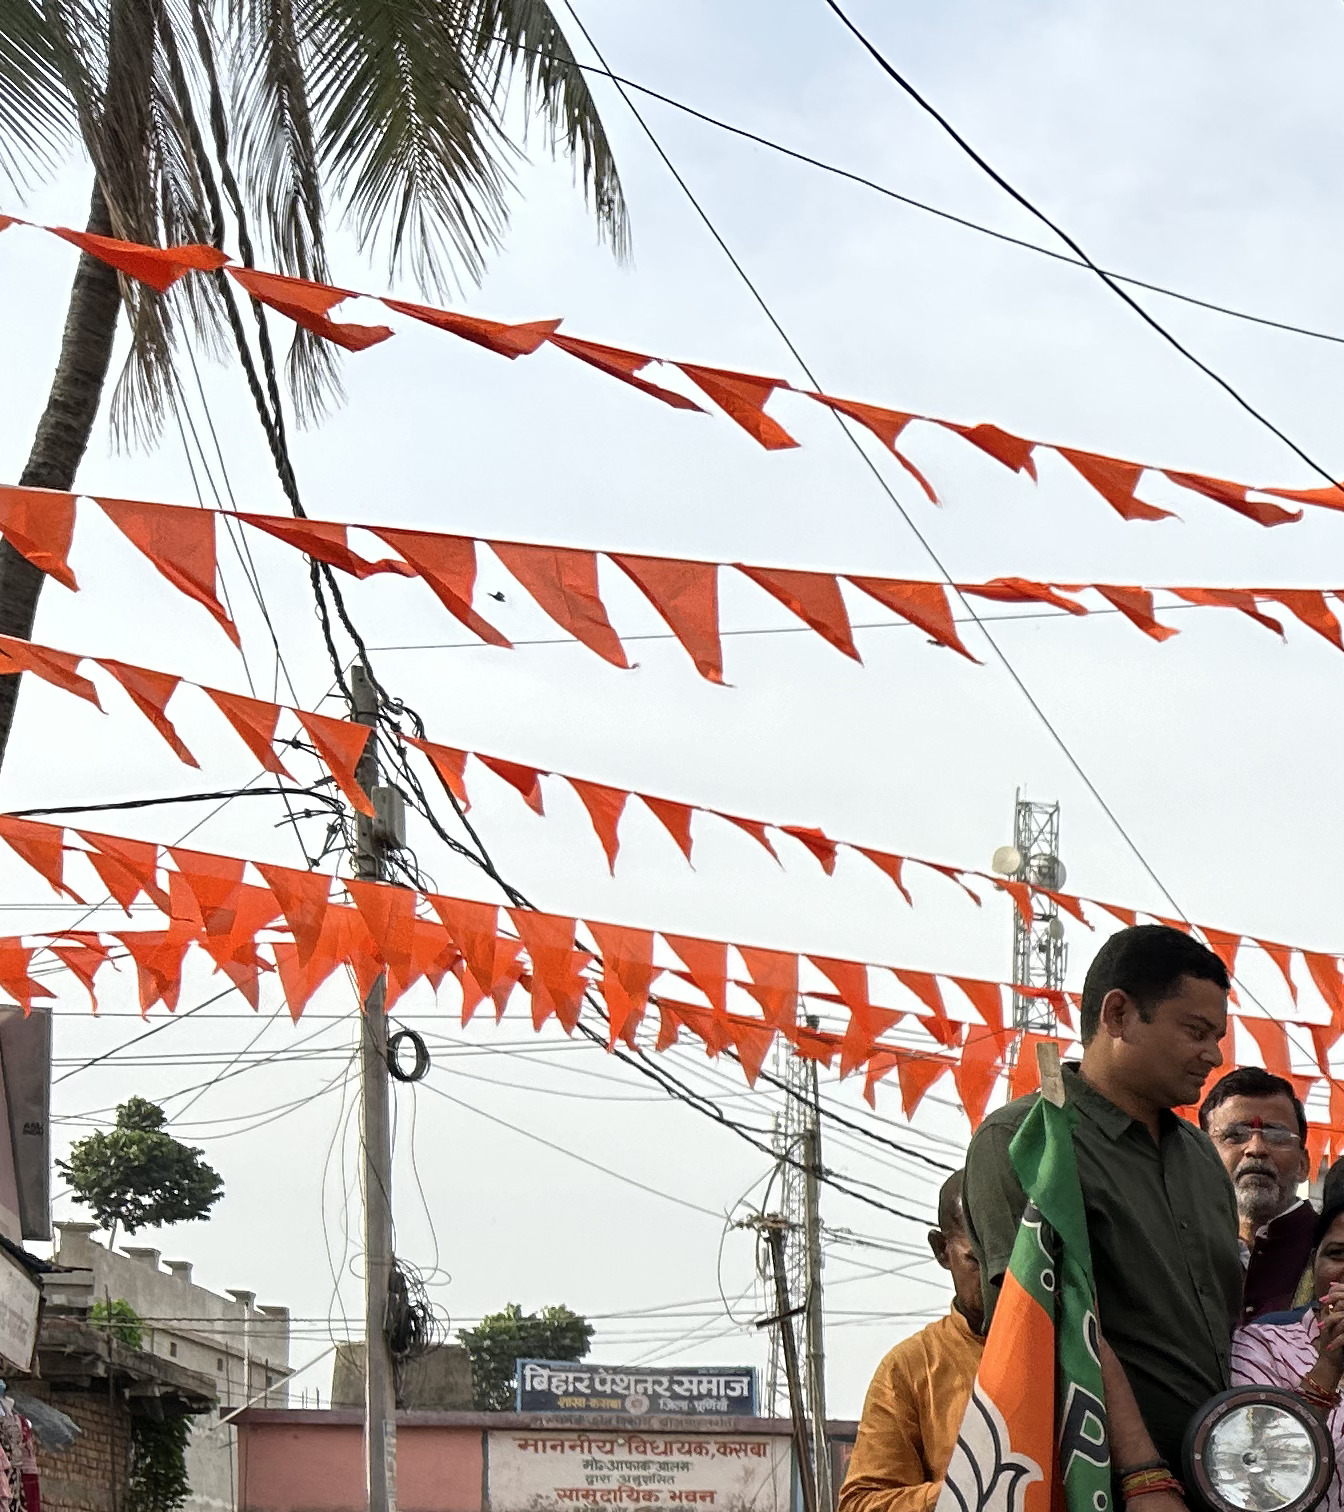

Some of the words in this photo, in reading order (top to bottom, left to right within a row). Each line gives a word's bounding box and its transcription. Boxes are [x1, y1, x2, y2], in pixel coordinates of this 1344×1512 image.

[524, 1365, 591, 1395] बिहार
[672, 1375, 750, 1397] समाज
[515, 1434, 614, 1455] माननीय
[554, 1484, 659, 1505] सामुदायिक
[669, 1488, 717, 1505] भवन
